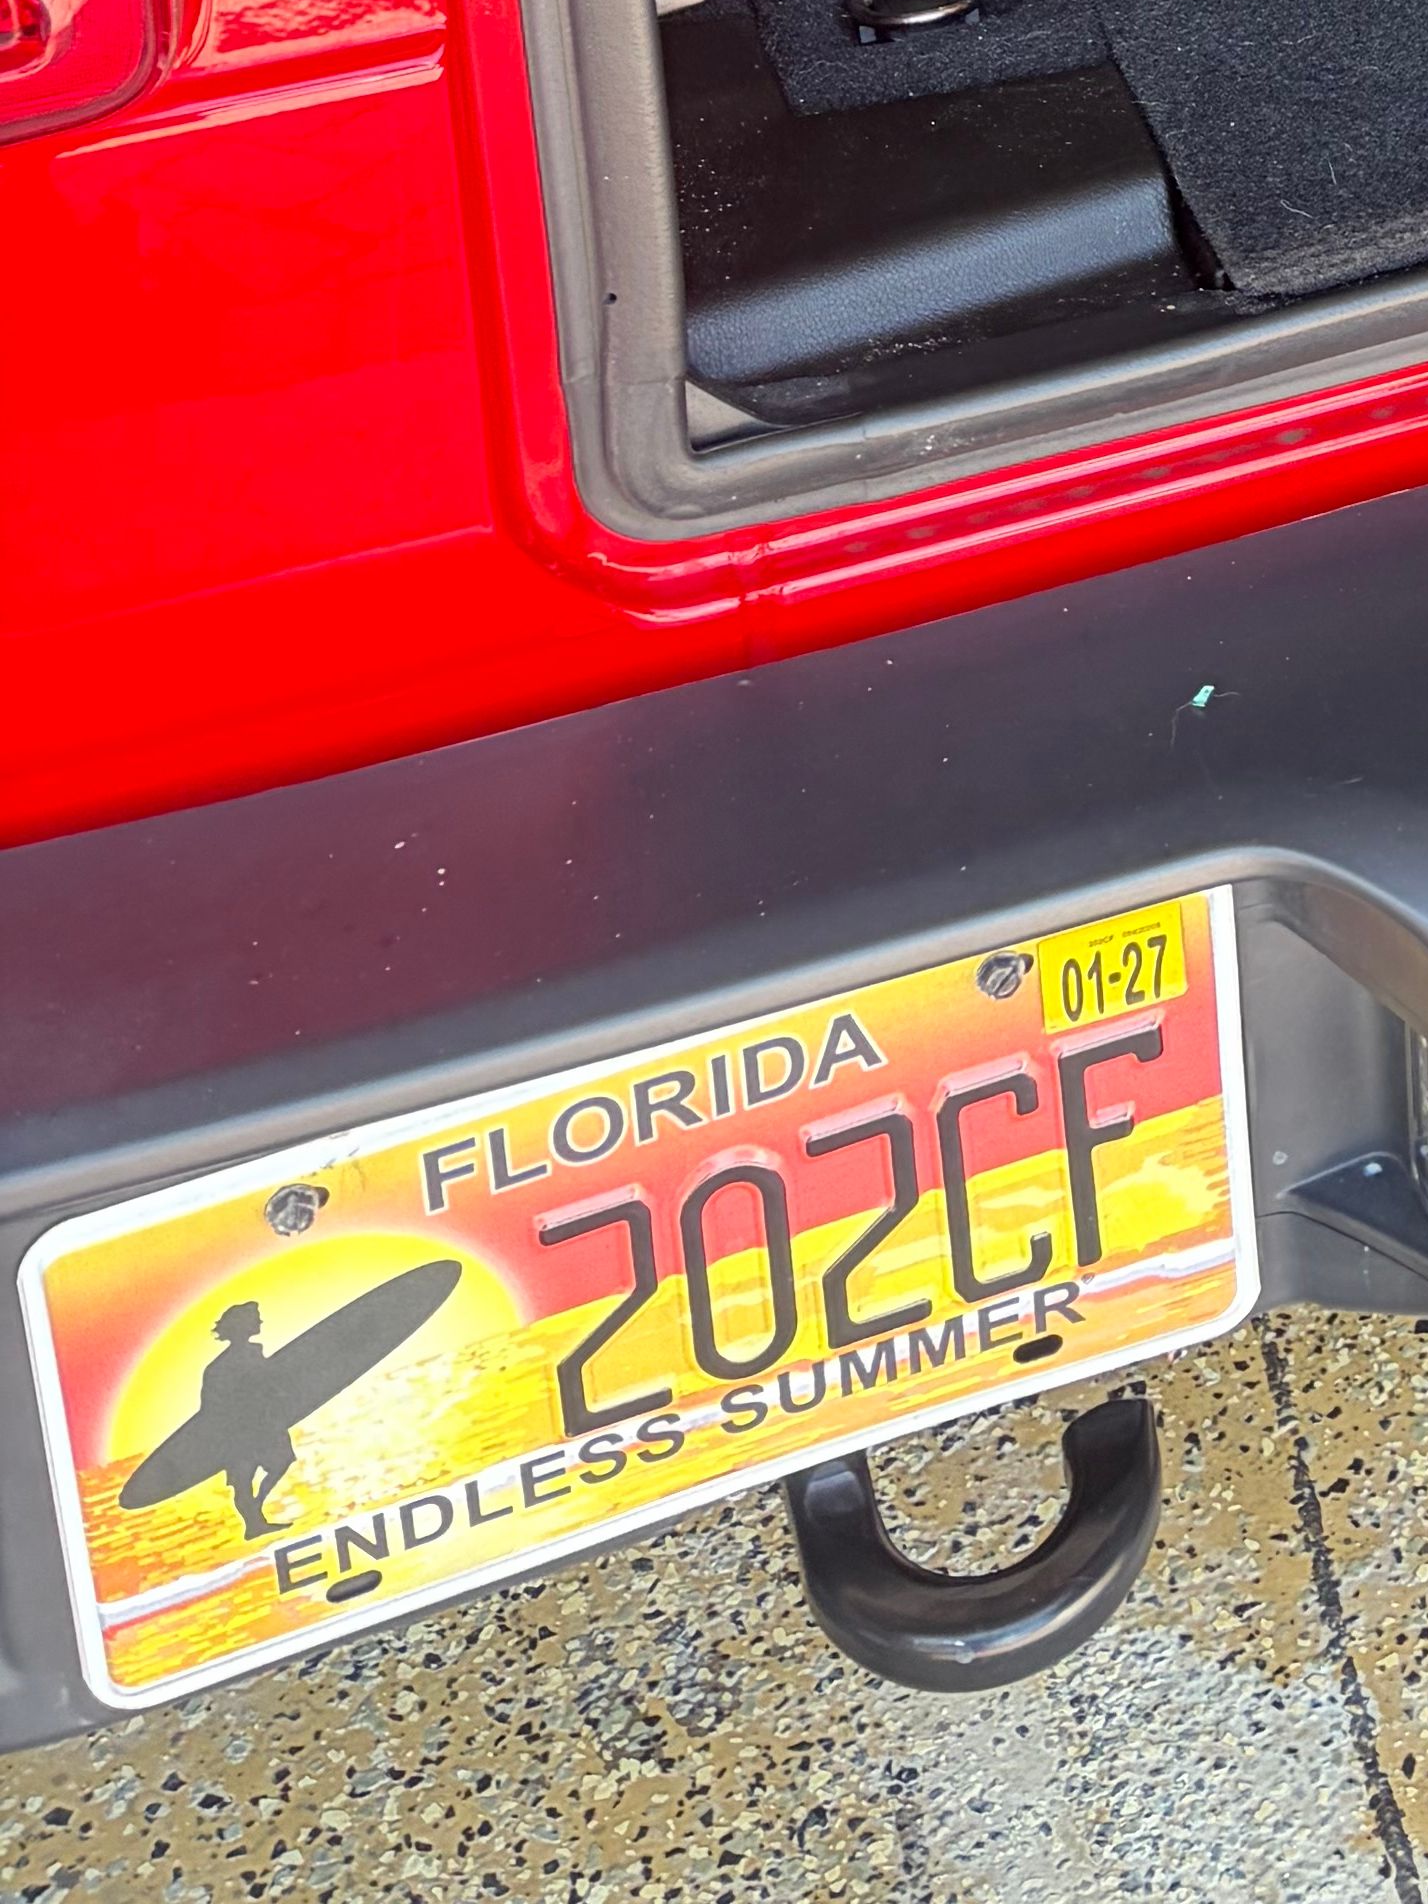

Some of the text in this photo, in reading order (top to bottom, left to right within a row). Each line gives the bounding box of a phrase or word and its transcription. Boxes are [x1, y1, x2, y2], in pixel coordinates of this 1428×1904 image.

[1061, 933, 1168, 1023] 01-27
[422, 1012, 884, 1213] FLORIDA
[538, 1024, 1165, 1438] 202CF
[273, 1280, 1087, 1593] ENDLESS SUMMER
